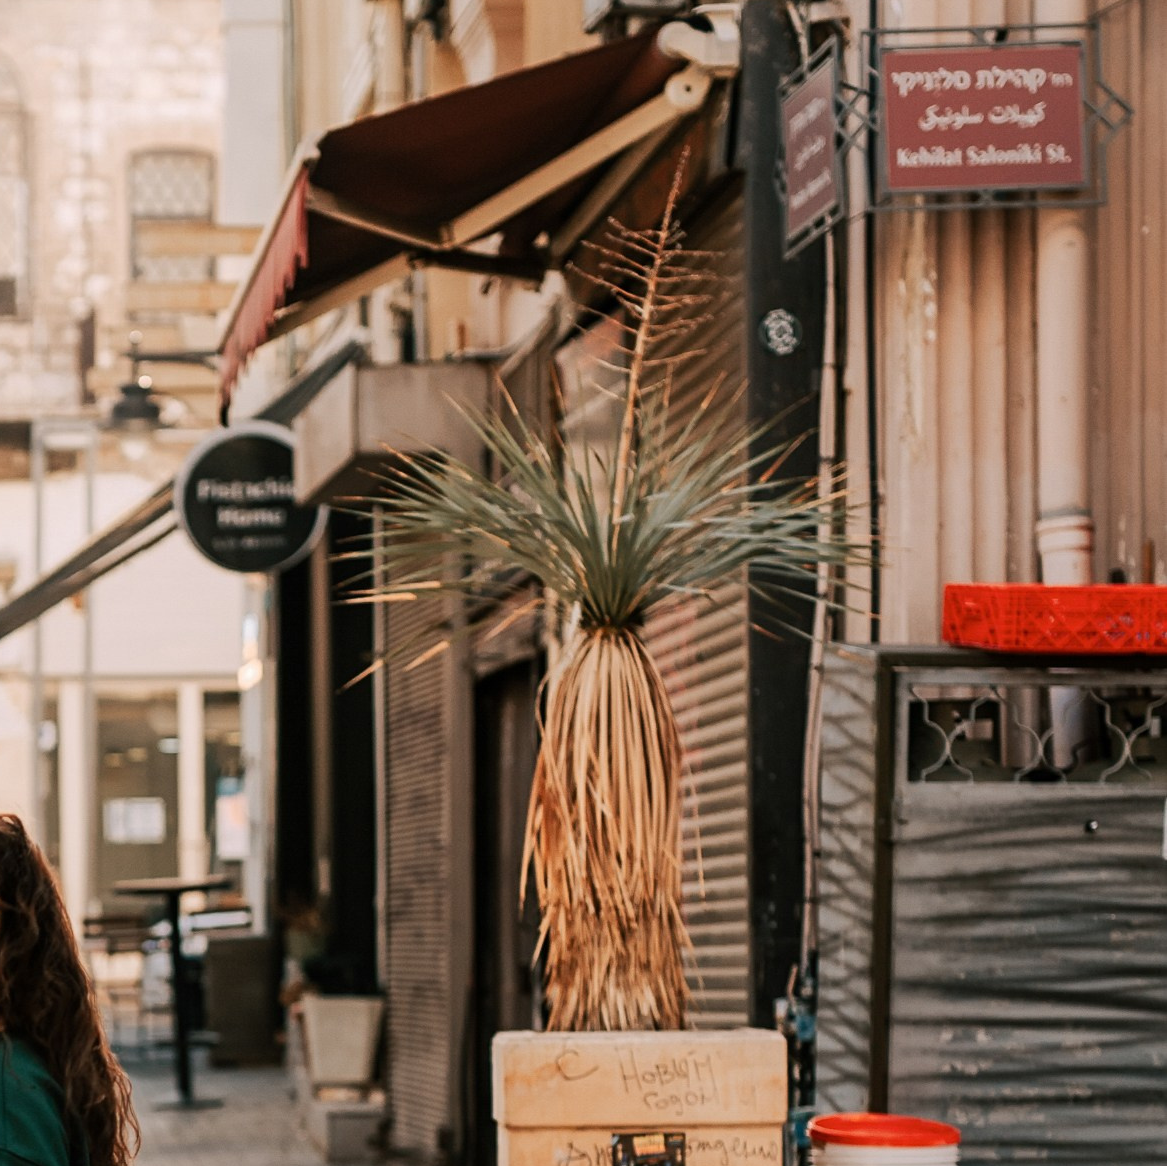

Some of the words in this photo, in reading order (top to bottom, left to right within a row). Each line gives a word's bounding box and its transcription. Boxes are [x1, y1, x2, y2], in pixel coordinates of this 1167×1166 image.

[896, 146, 963, 167] Kehilat
[966, 143, 1042, 166] Saloniki
[1045, 143, 1072, 164] St.
